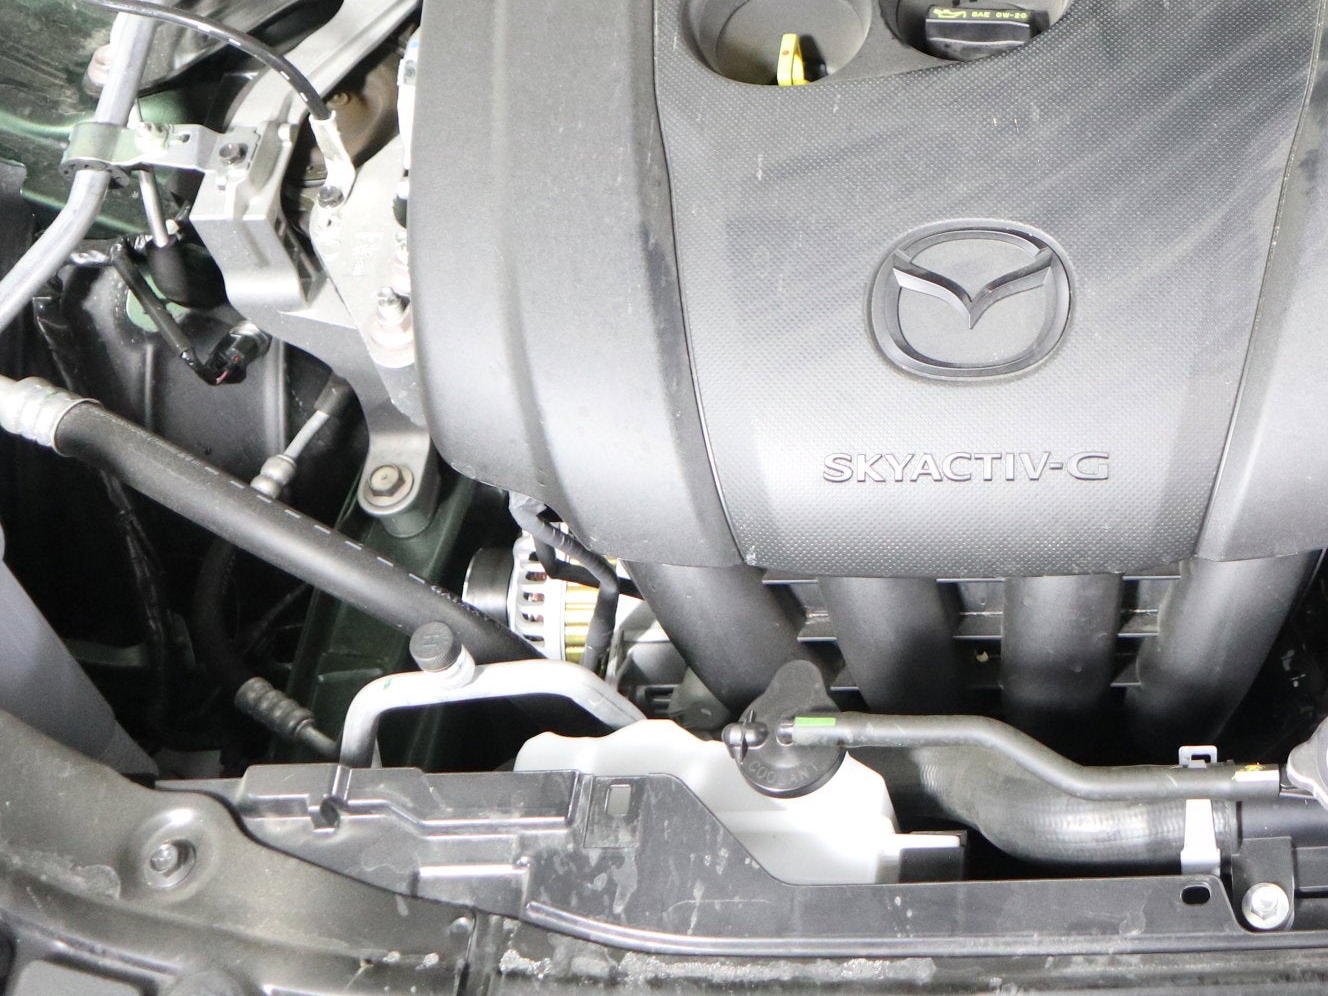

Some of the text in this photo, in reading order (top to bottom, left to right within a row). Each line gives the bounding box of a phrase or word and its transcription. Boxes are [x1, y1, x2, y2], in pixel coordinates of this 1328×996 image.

[971, 11, 1028, 20] SAE 0W-20
[822, 450, 1110, 483] SKYACTIV-G
